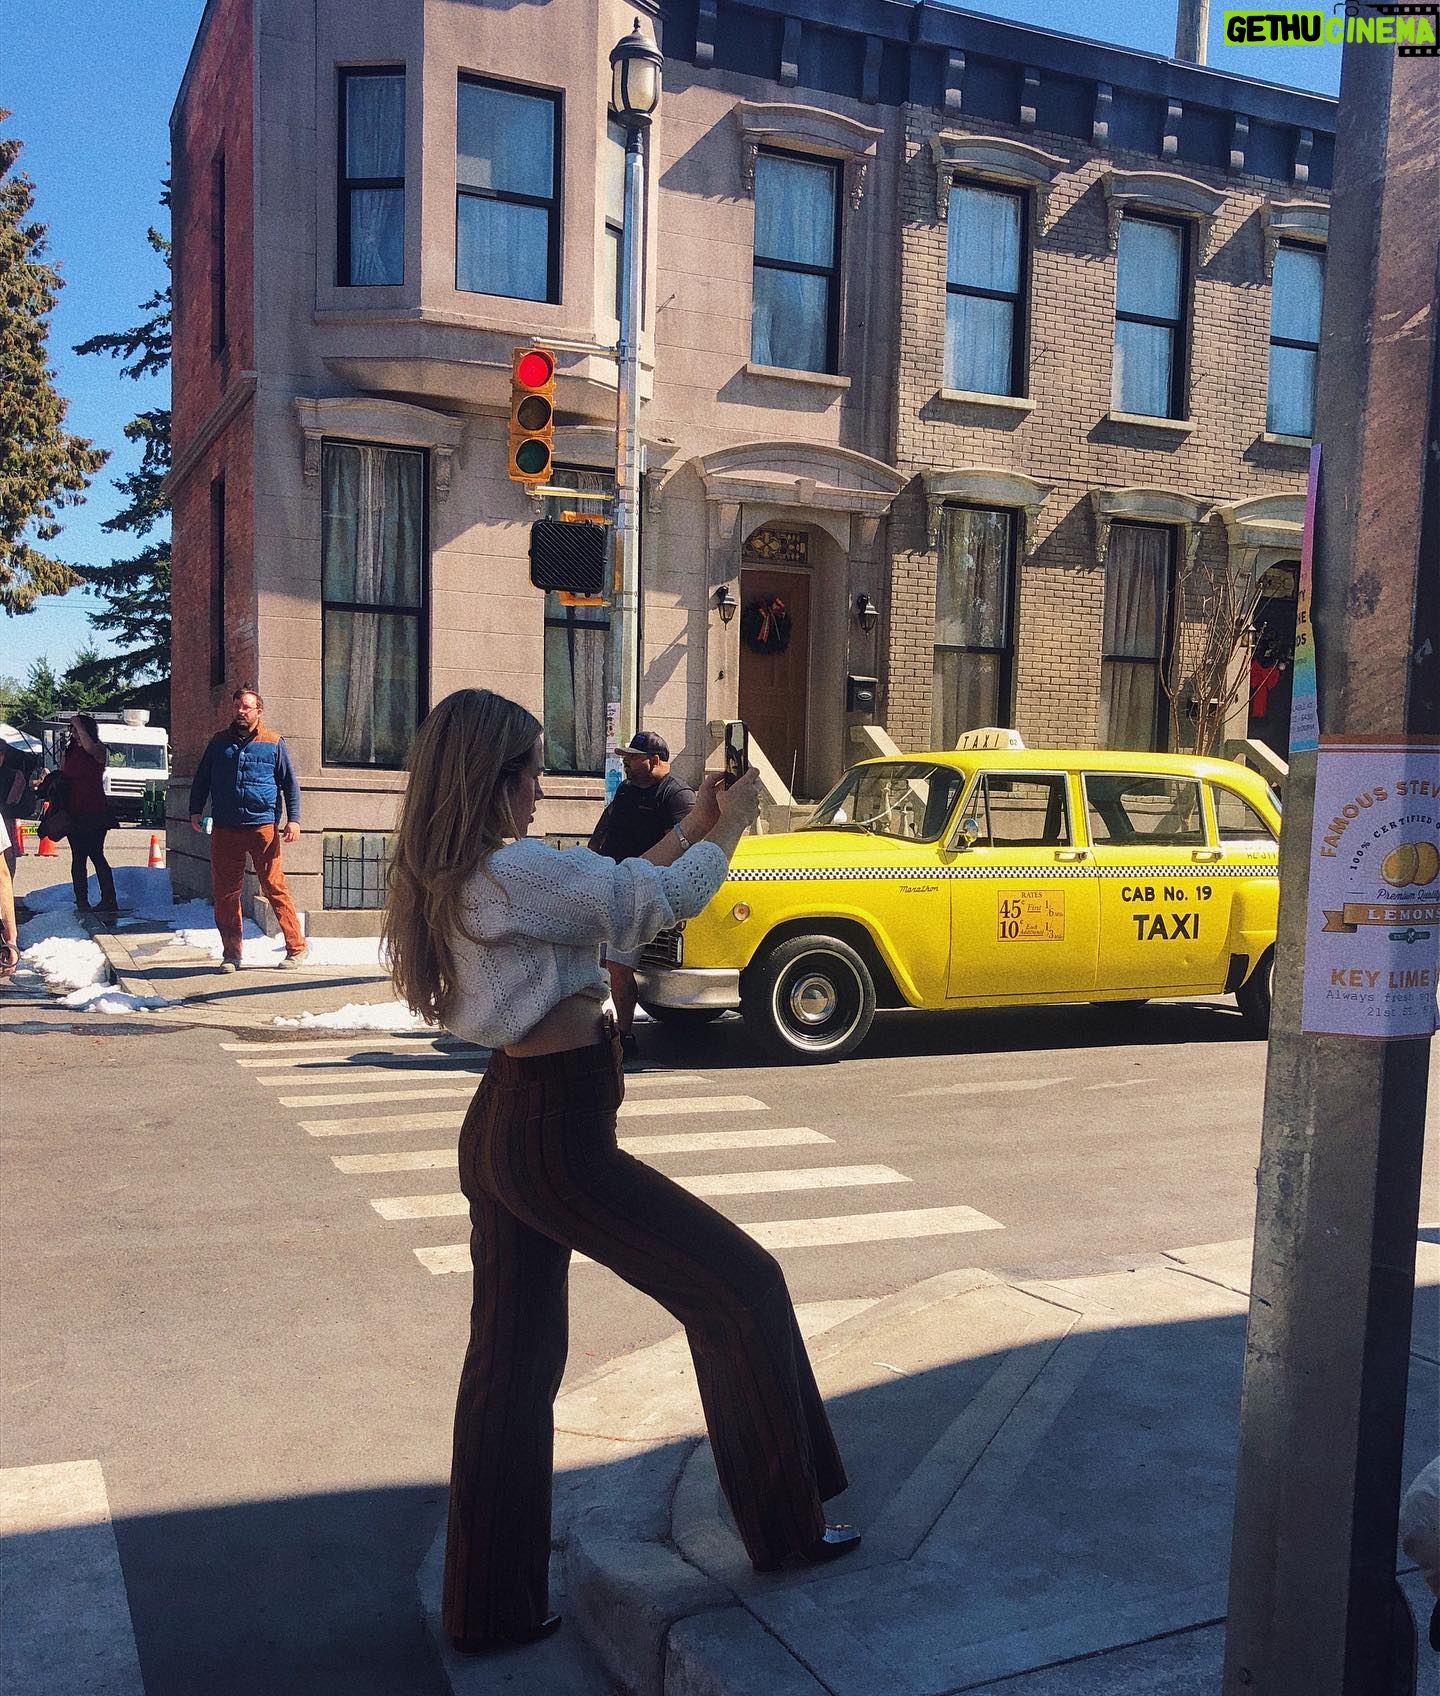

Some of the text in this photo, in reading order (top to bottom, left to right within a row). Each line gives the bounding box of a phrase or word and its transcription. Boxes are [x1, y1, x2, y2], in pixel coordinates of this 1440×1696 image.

[963, 733, 999, 749] TAXI
[1320, 786, 1388, 857] FAMOUS
[1349, 815, 1432, 871] 100% CERTIFIED
[1121, 885, 1212, 902] CAB No. 19
[1376, 888, 1415, 900] Premium
[1133, 913, 1200, 940] TAXI
[1330, 968, 1431, 989] KEY LIME
[1325, 989, 1376, 1003] Always
[1367, 1006, 1397, 1018] 21st
